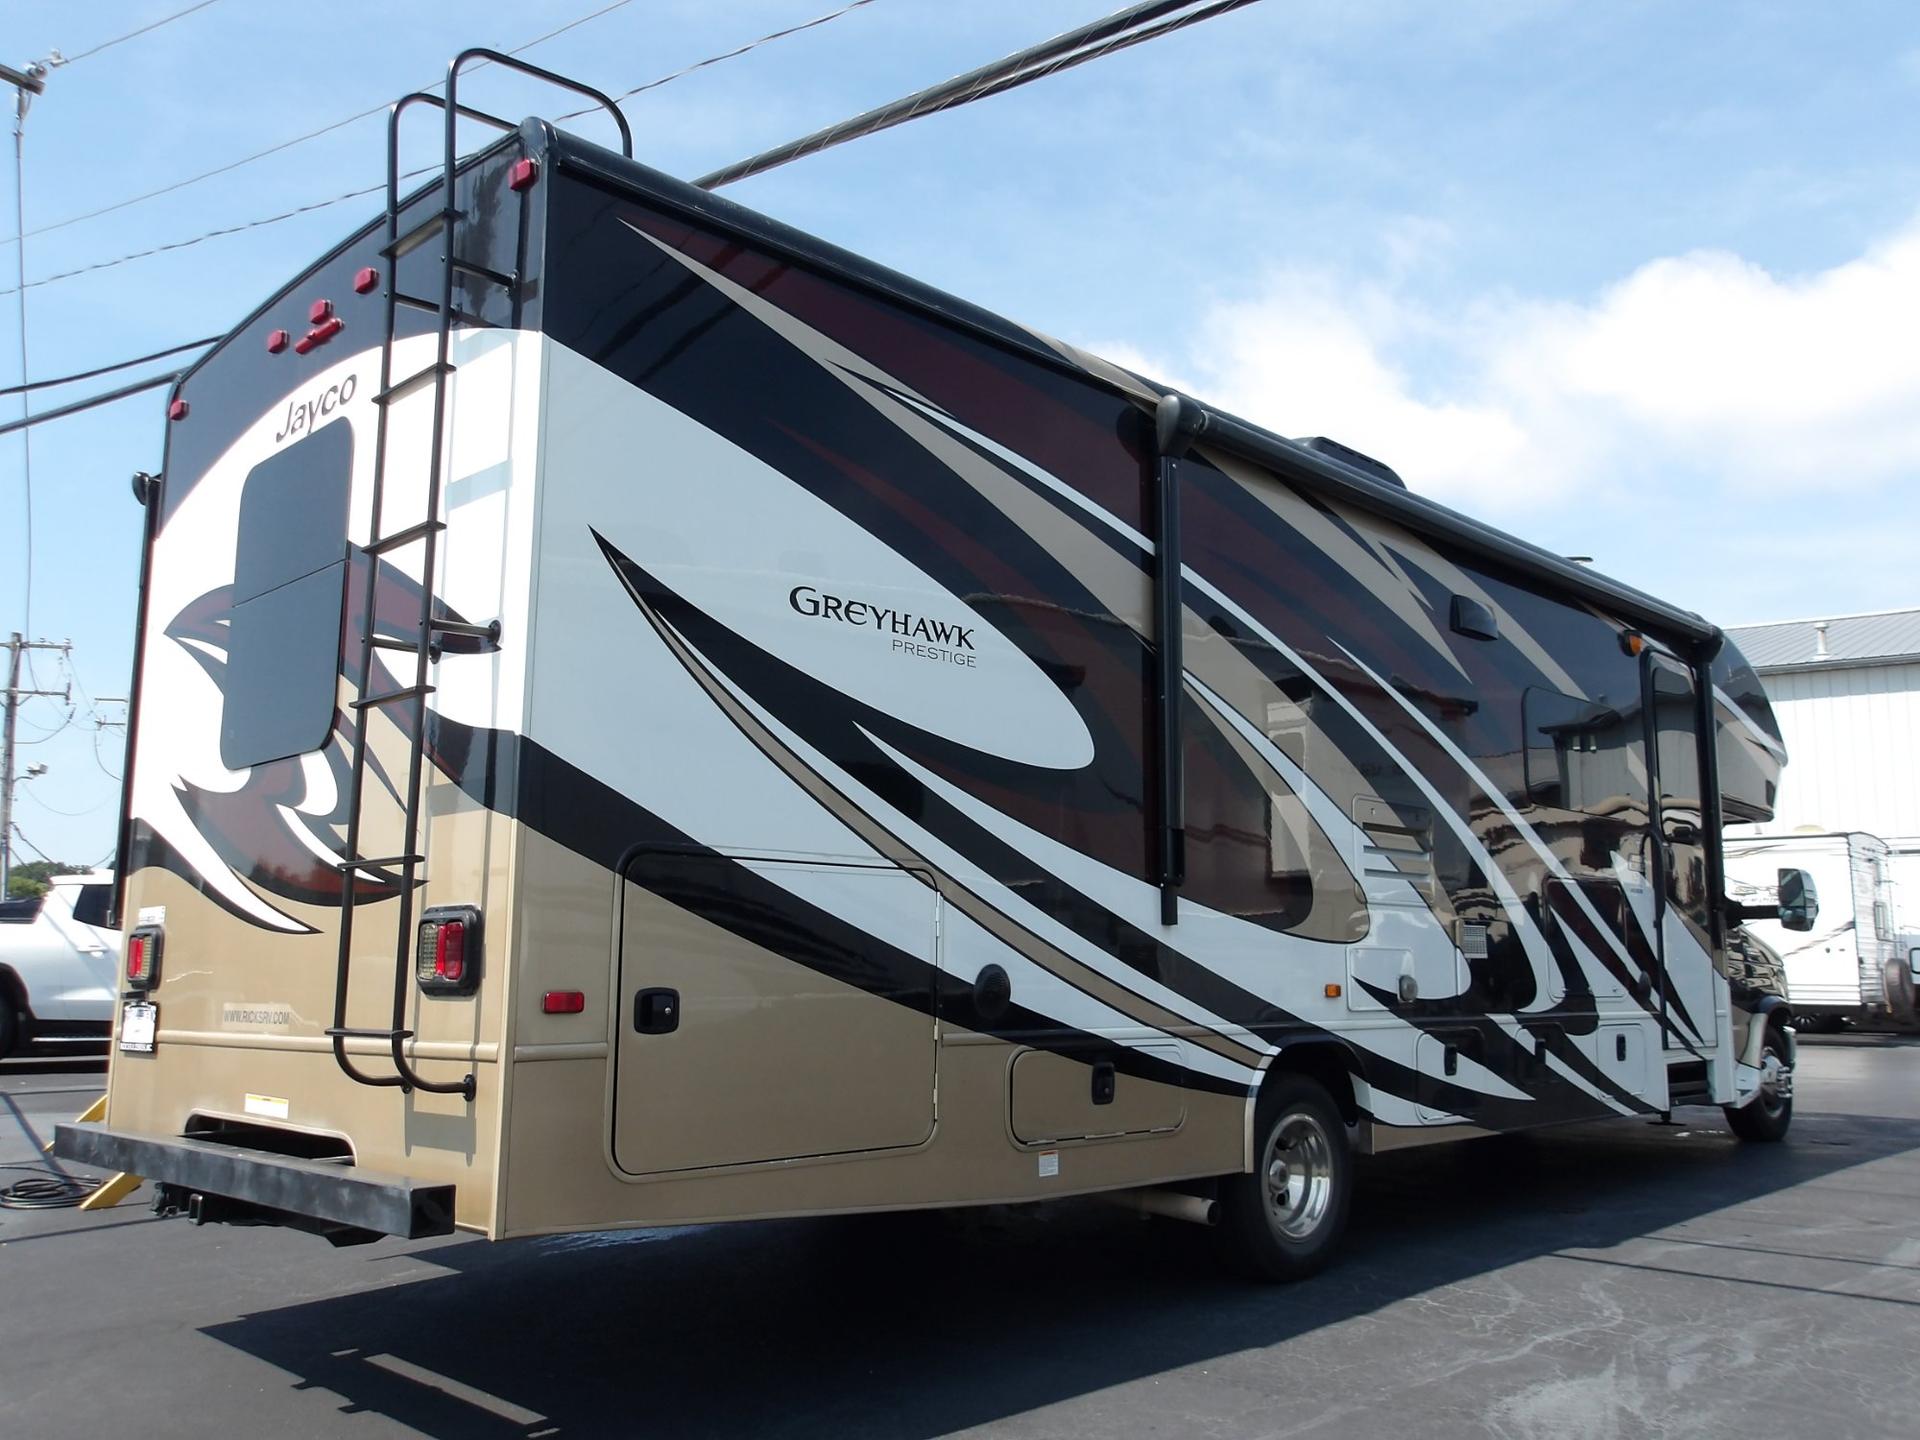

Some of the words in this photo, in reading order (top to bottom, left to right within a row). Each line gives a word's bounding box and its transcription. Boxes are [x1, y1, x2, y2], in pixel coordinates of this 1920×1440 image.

[276, 373, 357, 443] Jayco
[789, 585, 976, 651] GREYHAWK
[892, 638, 977, 668] PRESTIGE
